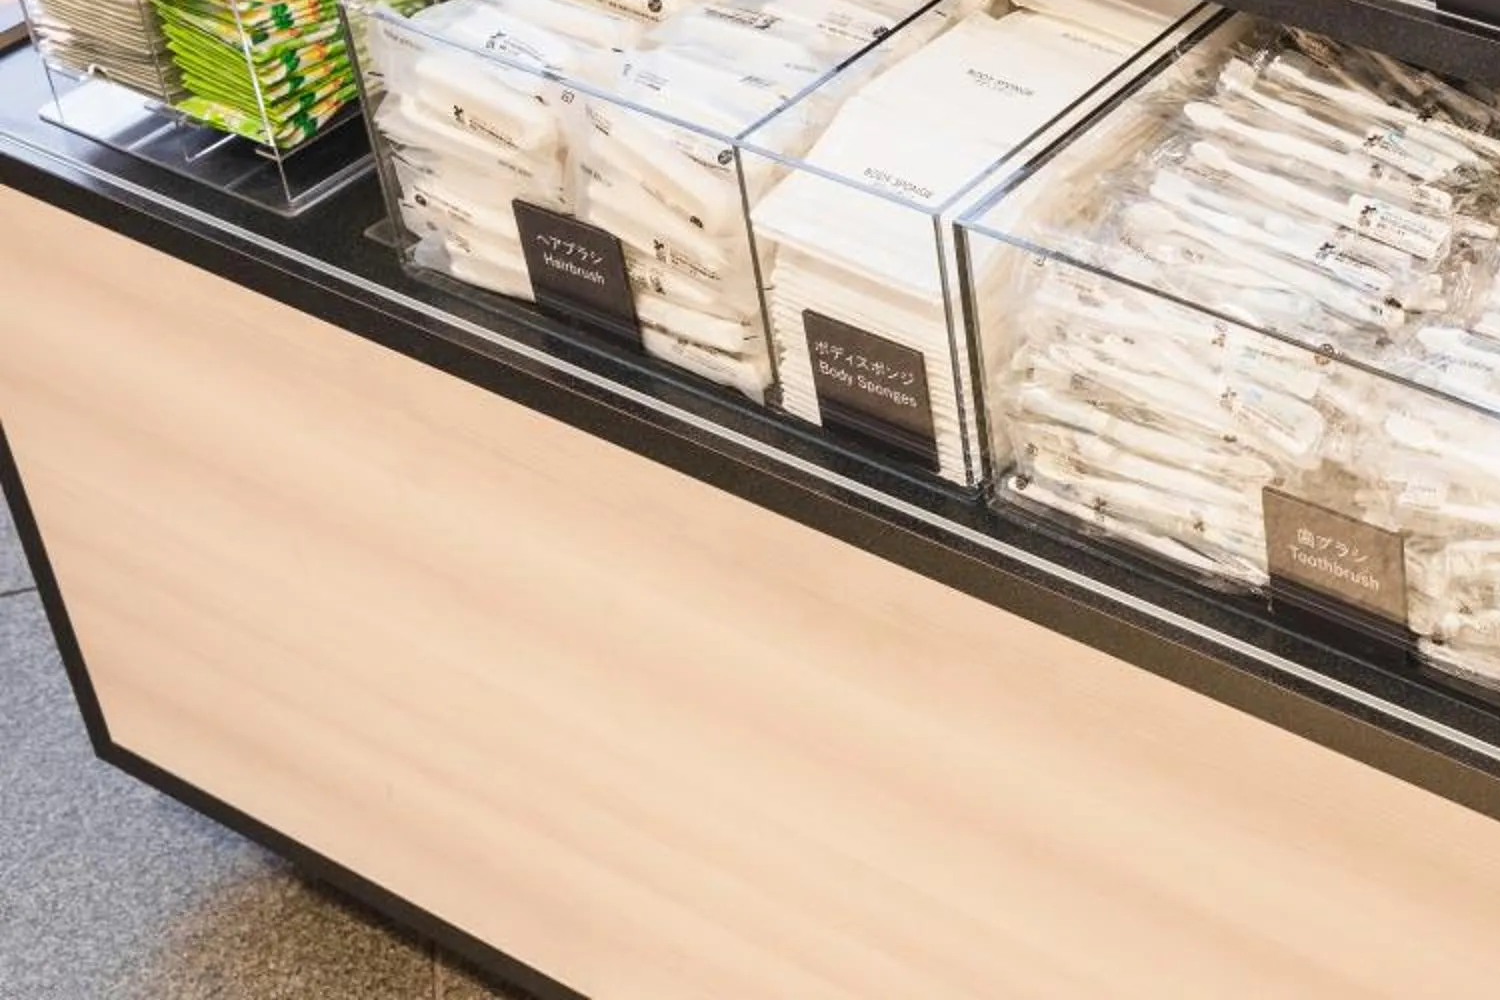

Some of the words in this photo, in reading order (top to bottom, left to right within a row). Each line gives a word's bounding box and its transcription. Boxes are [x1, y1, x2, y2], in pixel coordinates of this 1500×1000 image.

[537, 235, 603, 264] ヘアブラシ
[543, 252, 605, 286] Hairbrush
[819, 360, 853, 387] Body
[857, 375, 917, 408] Sponges
[1296, 528, 1369, 562] 歯ブラシ
[1287, 544, 1379, 593] Toothbrush
